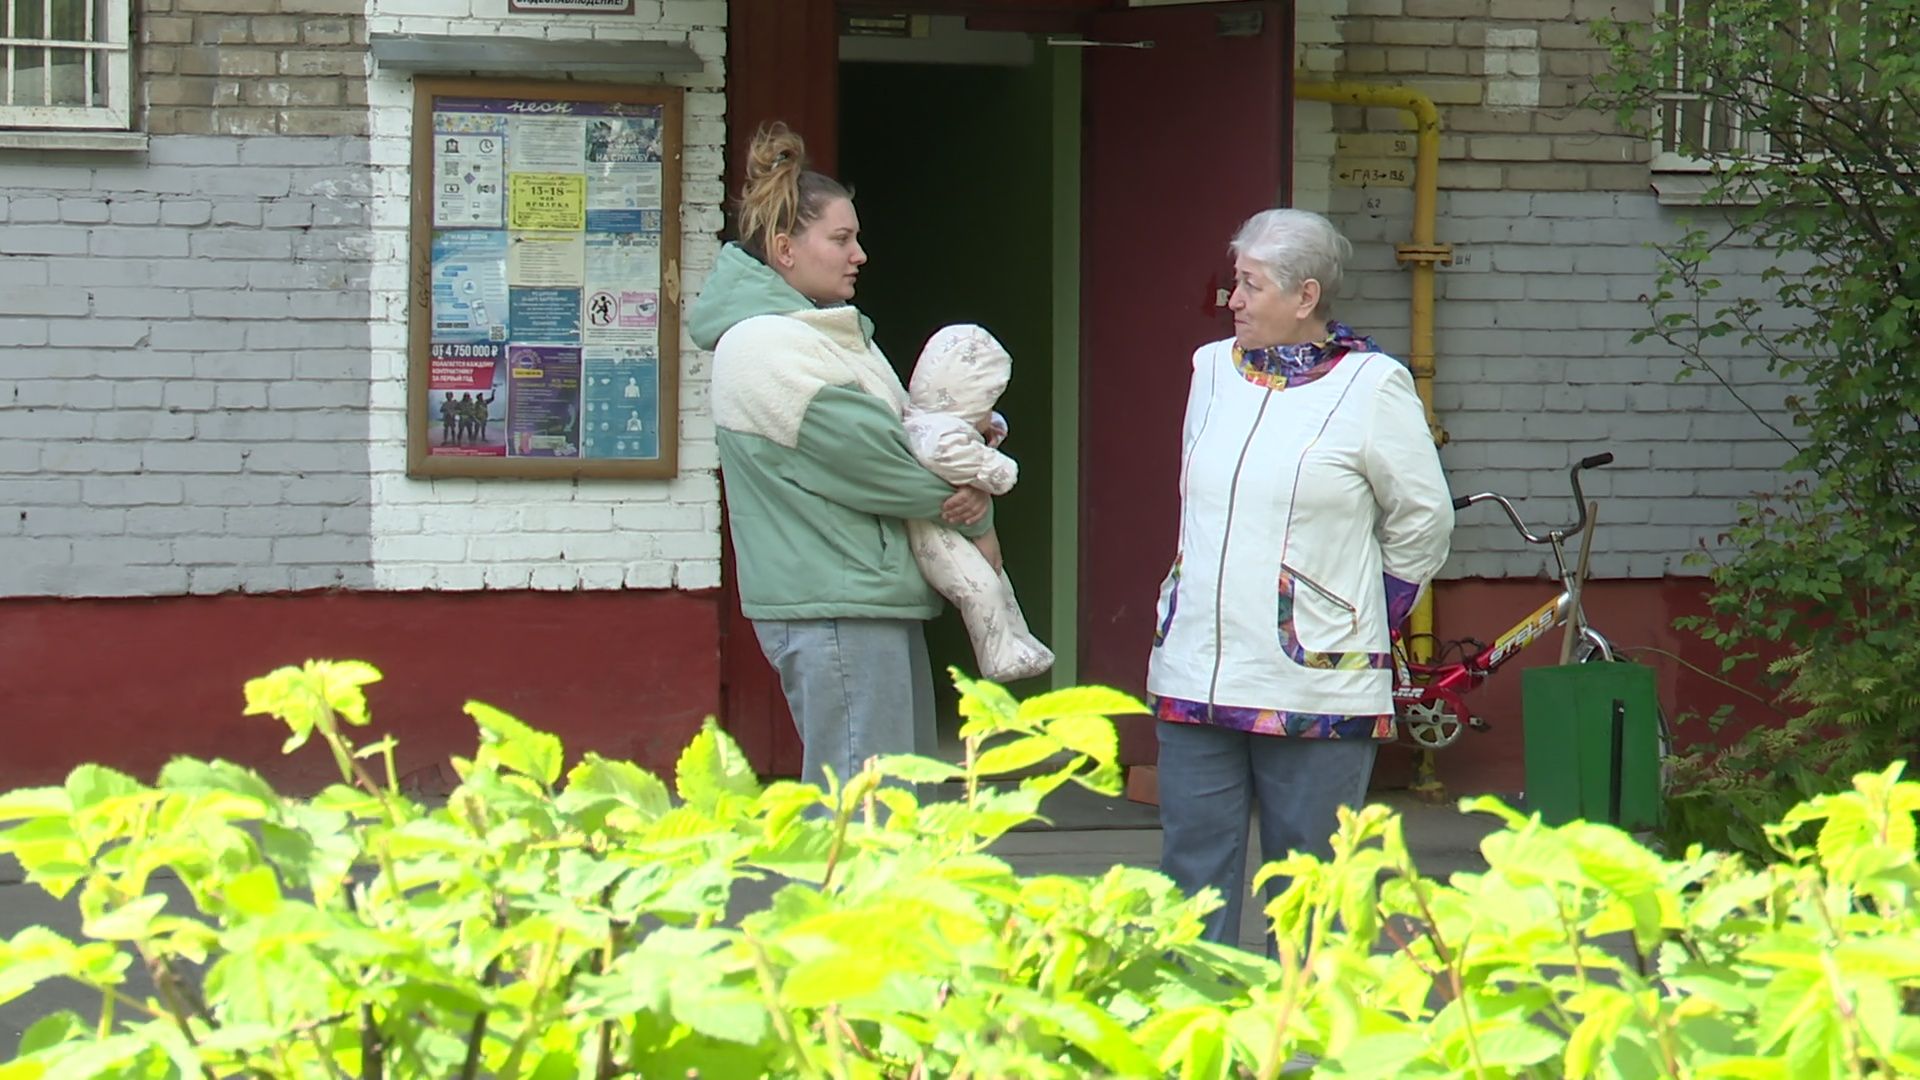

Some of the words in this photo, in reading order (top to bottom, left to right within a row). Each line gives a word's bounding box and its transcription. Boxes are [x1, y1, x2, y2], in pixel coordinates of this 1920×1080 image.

[596, 153, 608, 162] НА
[1352, 169, 1378, 181] ГАЗ
[432, 345, 444, 357] ОТ
[445, 345, 452, 357] 4
[453, 345, 471, 357] 750
[472, 345, 490, 357] 000
[1489, 609, 1554, 667] STELS
